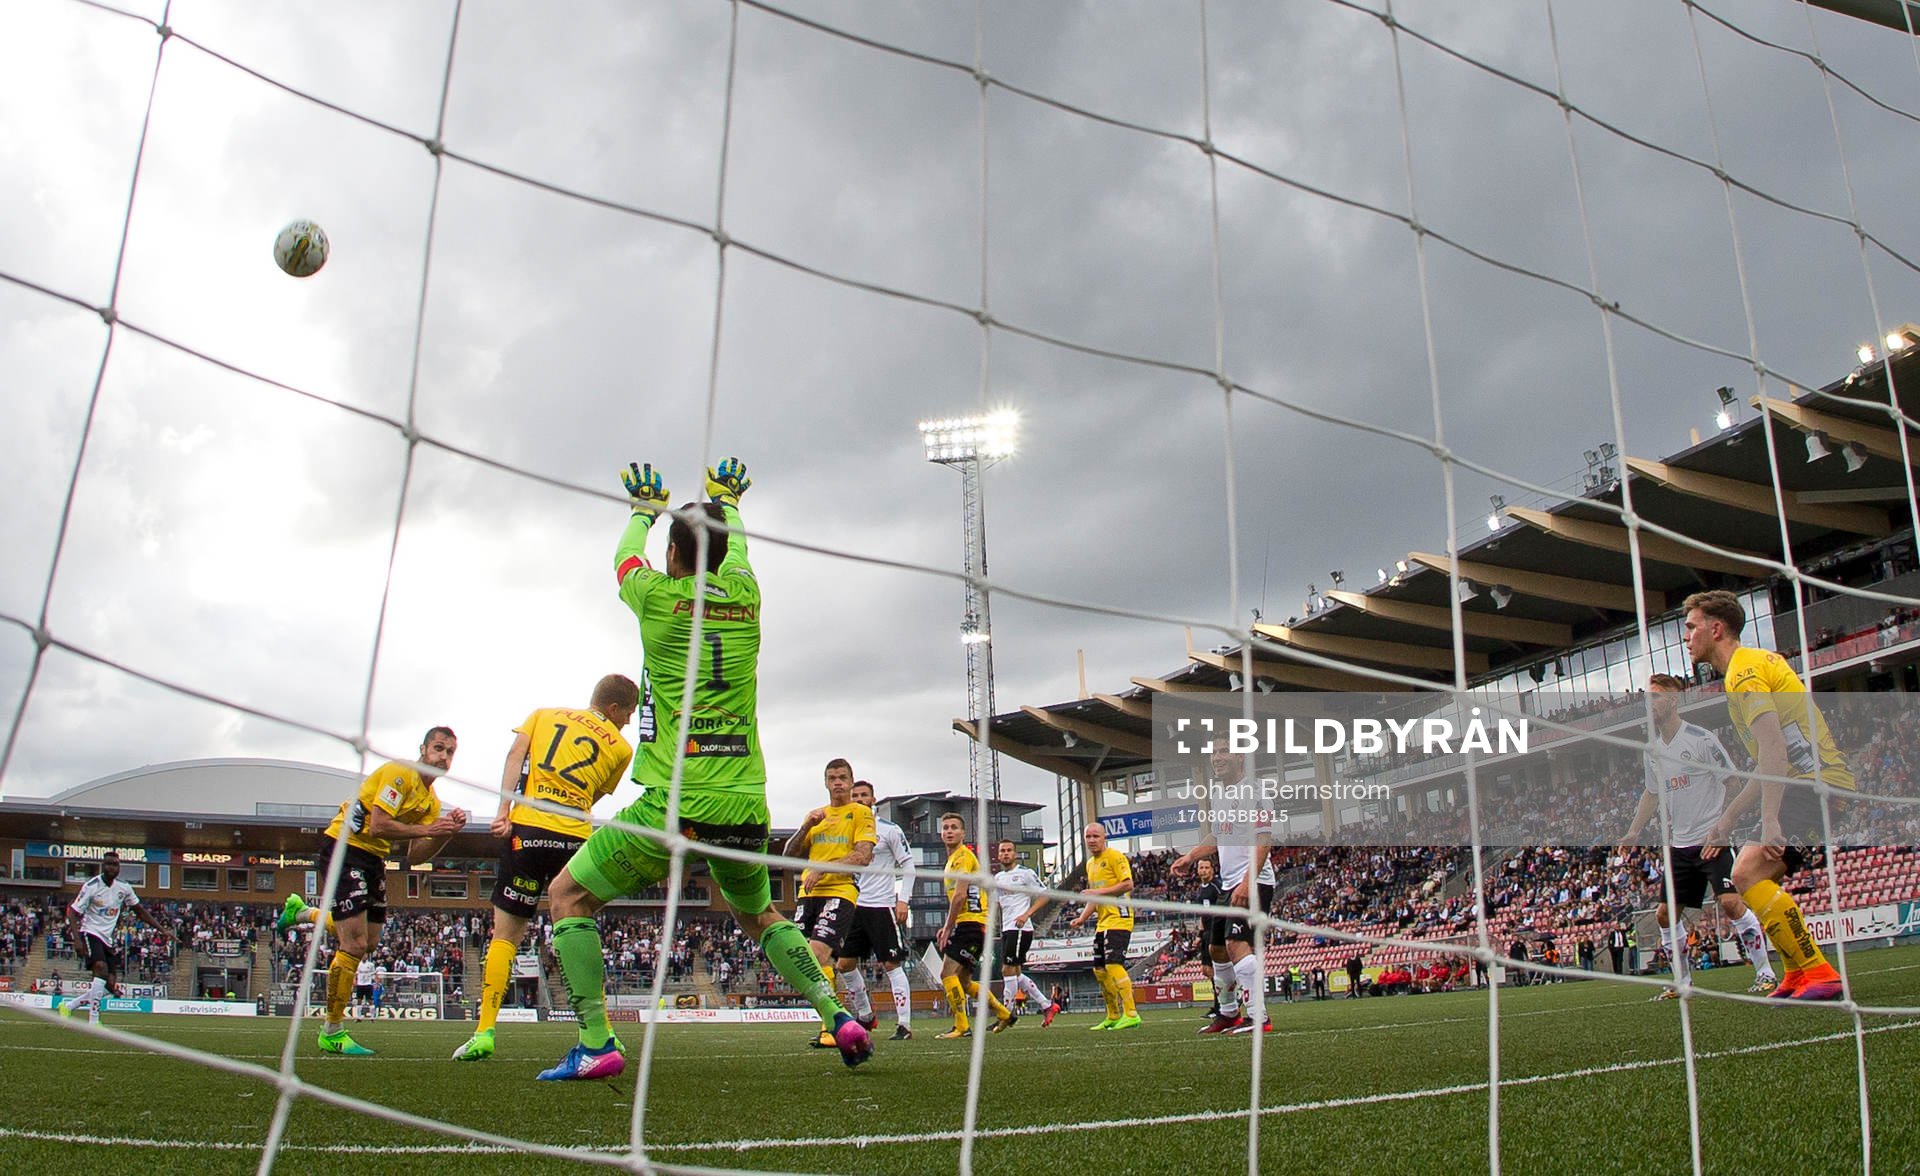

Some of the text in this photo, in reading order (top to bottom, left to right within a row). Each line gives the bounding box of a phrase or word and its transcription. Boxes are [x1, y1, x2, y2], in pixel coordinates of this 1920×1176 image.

[703, 631, 731, 692] 1
[553, 709, 618, 747] PULSEN
[537, 723, 600, 791] 12
[522, 838, 565, 850] OLOFSSON
[182, 853, 232, 864] SHARP
[339, 898, 354, 913] 20
[179, 1003, 224, 1014] sitevision
